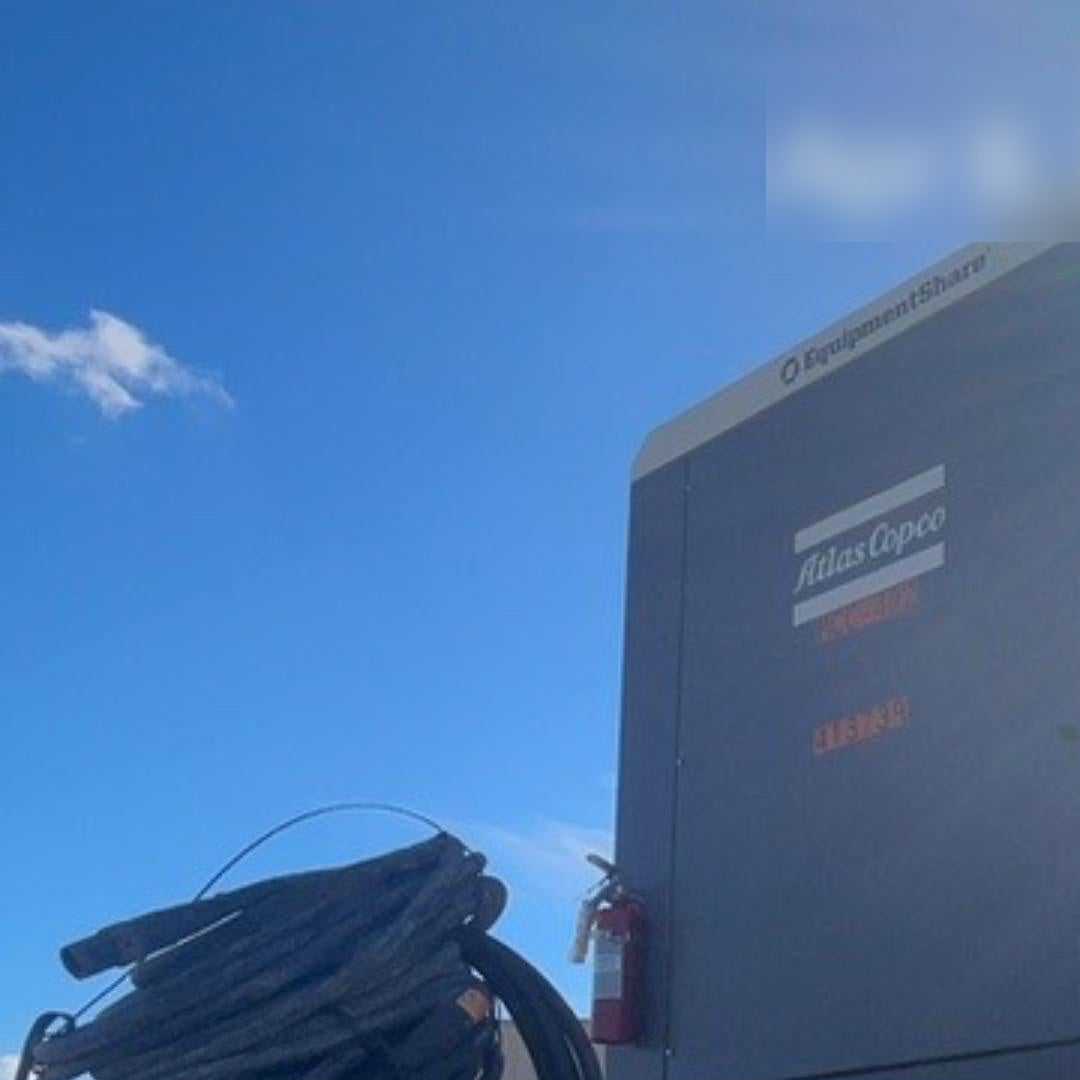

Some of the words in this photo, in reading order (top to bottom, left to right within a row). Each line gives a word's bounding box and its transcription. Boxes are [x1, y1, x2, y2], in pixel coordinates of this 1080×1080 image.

[803, 252, 987, 368] EquipmentShare
[793, 538, 867, 594] Atlas
[867, 506, 946, 560] Copco
